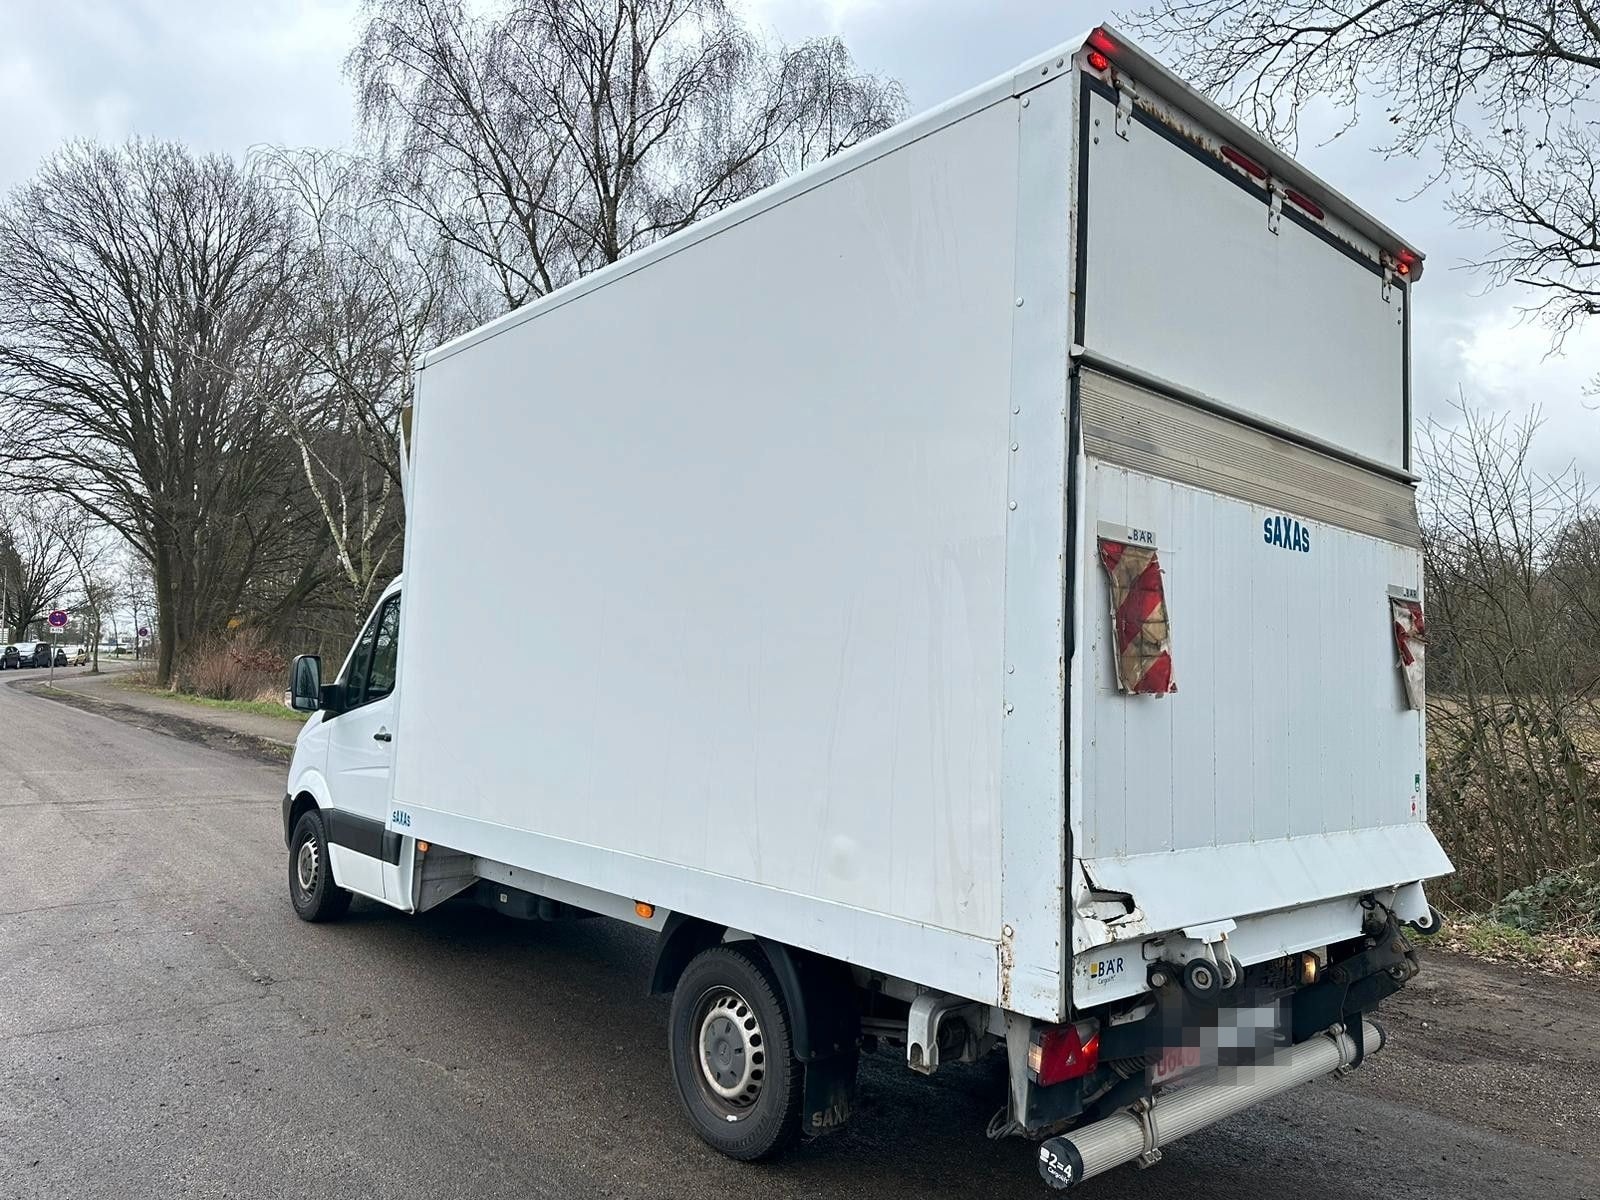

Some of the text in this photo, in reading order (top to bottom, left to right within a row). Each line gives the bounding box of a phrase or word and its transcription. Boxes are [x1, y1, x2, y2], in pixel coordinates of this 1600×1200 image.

[1133, 529, 1153, 544] BÄR
[1263, 515, 1310, 553] SAXAS
[392, 810, 411, 827] SAXAS
[1099, 957, 1124, 977] BÄR
[1048, 1153, 1072, 1179] 2=4
